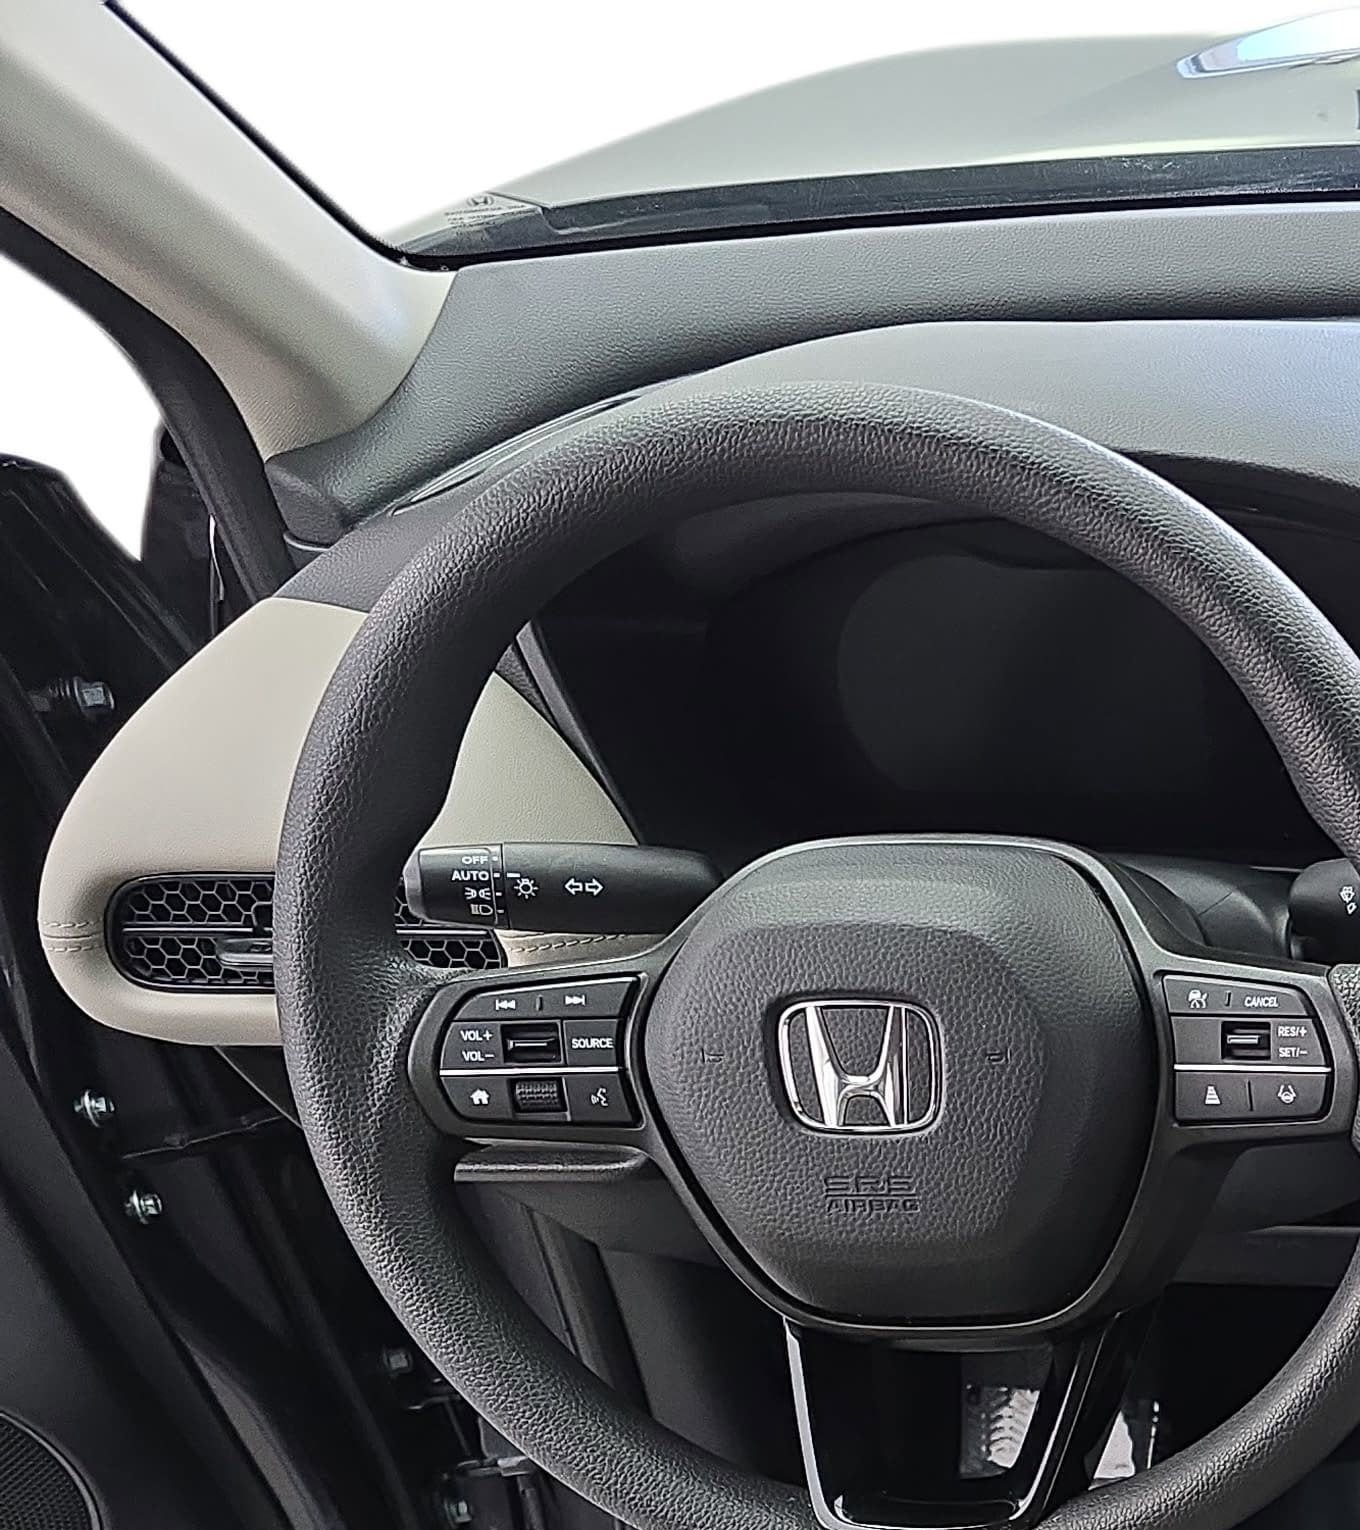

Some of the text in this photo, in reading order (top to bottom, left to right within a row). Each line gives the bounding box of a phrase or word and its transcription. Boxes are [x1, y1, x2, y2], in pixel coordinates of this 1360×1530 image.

[461, 856, 489, 865] OFF
[451, 870, 490, 881] AUTO
[1244, 996, 1280, 1008] CANCEL
[460, 1029, 493, 1041] VOL+
[571, 1037, 614, 1049] SOURCE
